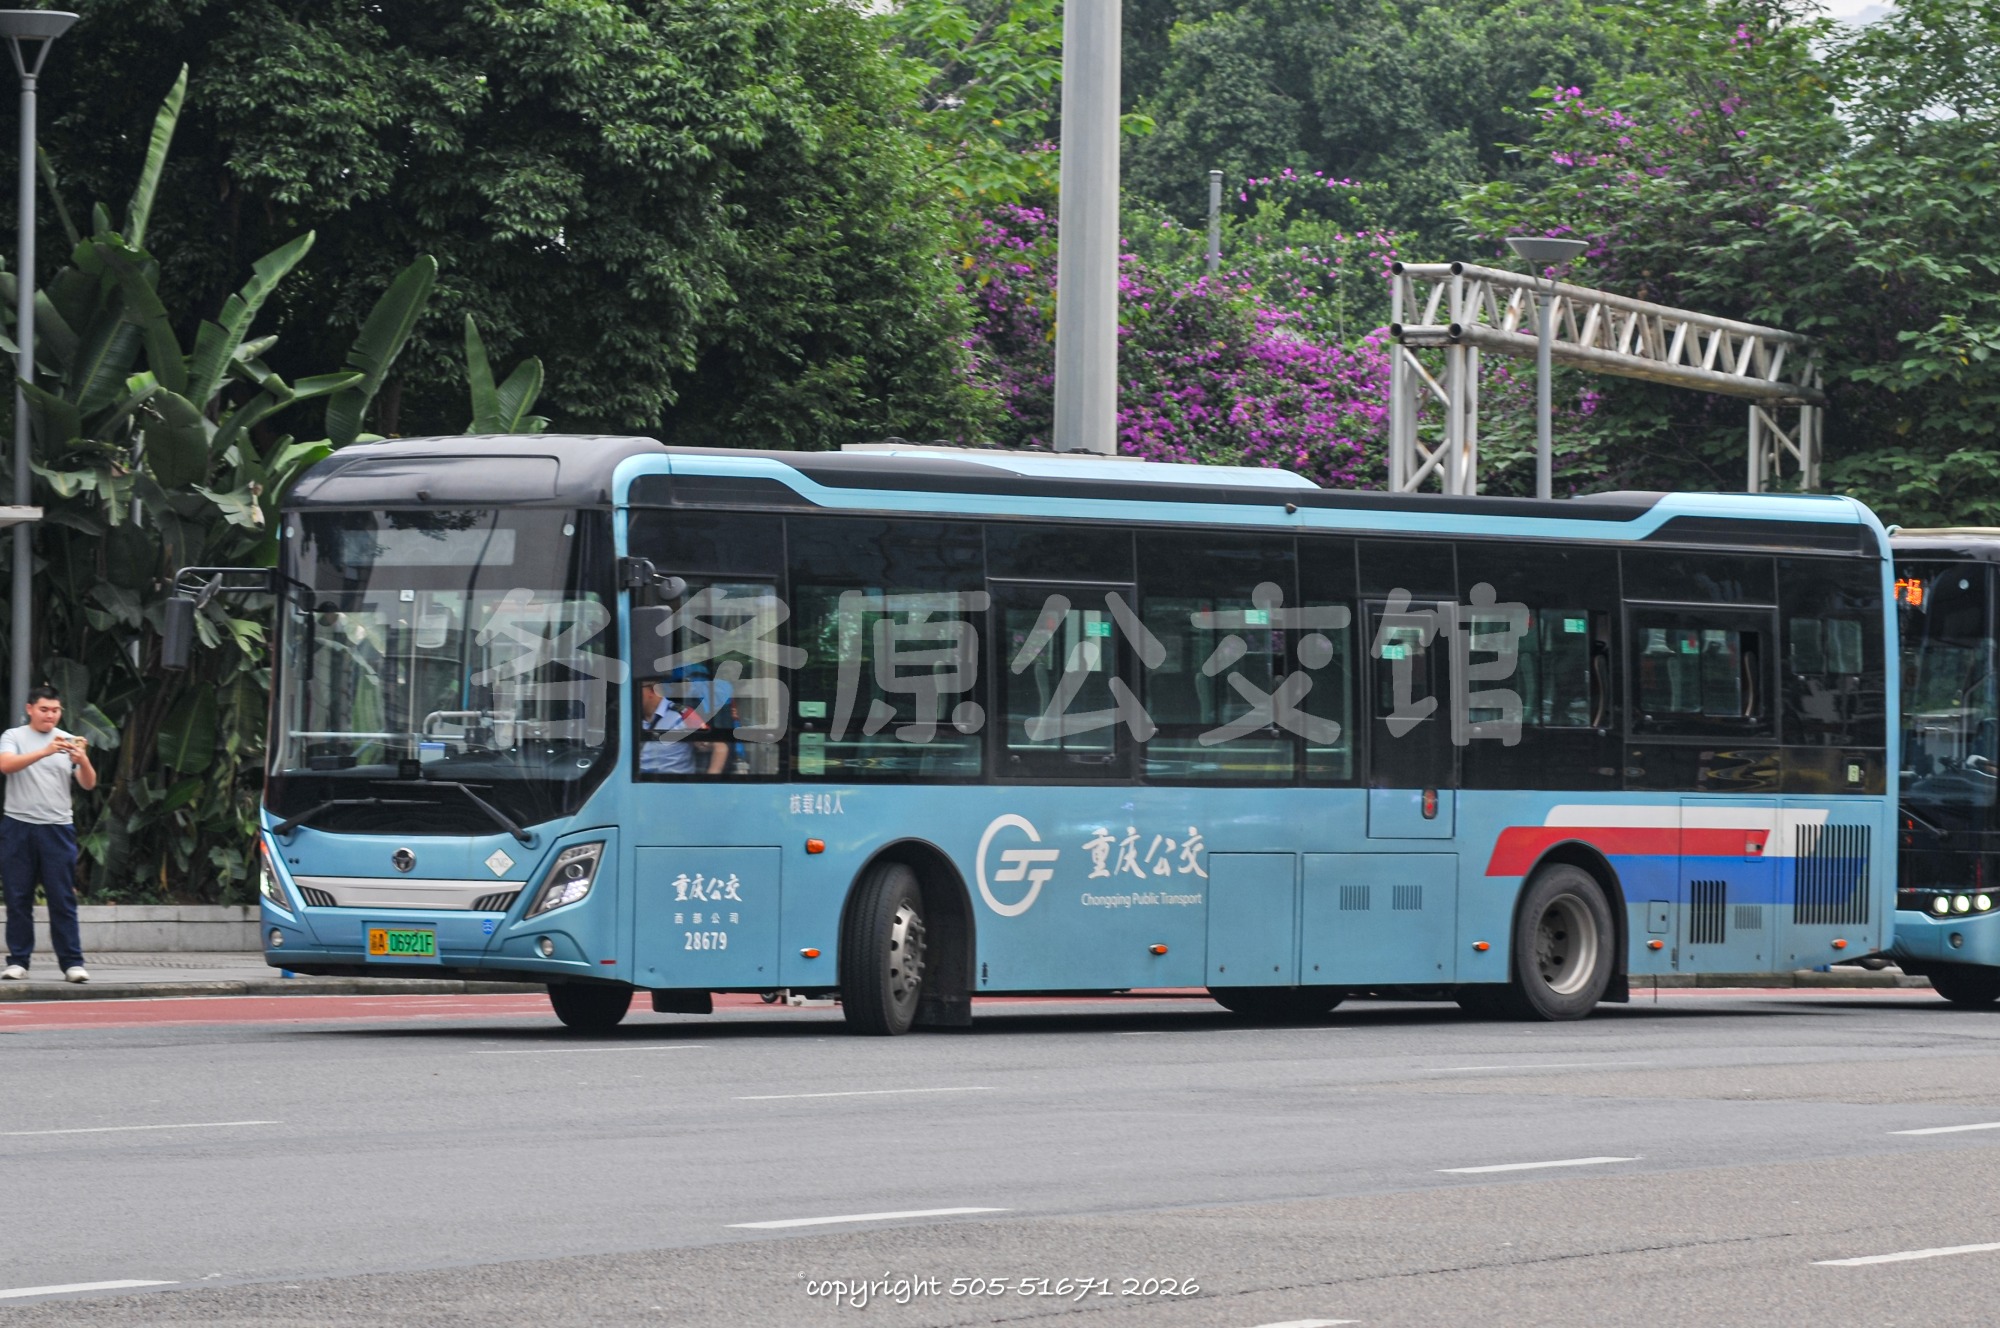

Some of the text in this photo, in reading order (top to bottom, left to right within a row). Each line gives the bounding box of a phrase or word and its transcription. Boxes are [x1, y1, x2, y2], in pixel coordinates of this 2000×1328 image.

[1081, 826, 1209, 879] 重庆公交
[671, 873, 743, 902] 重庆公交
[1081, 892, 1202, 909] Chongqing Public Transport
[684, 931, 728, 950] 28679
